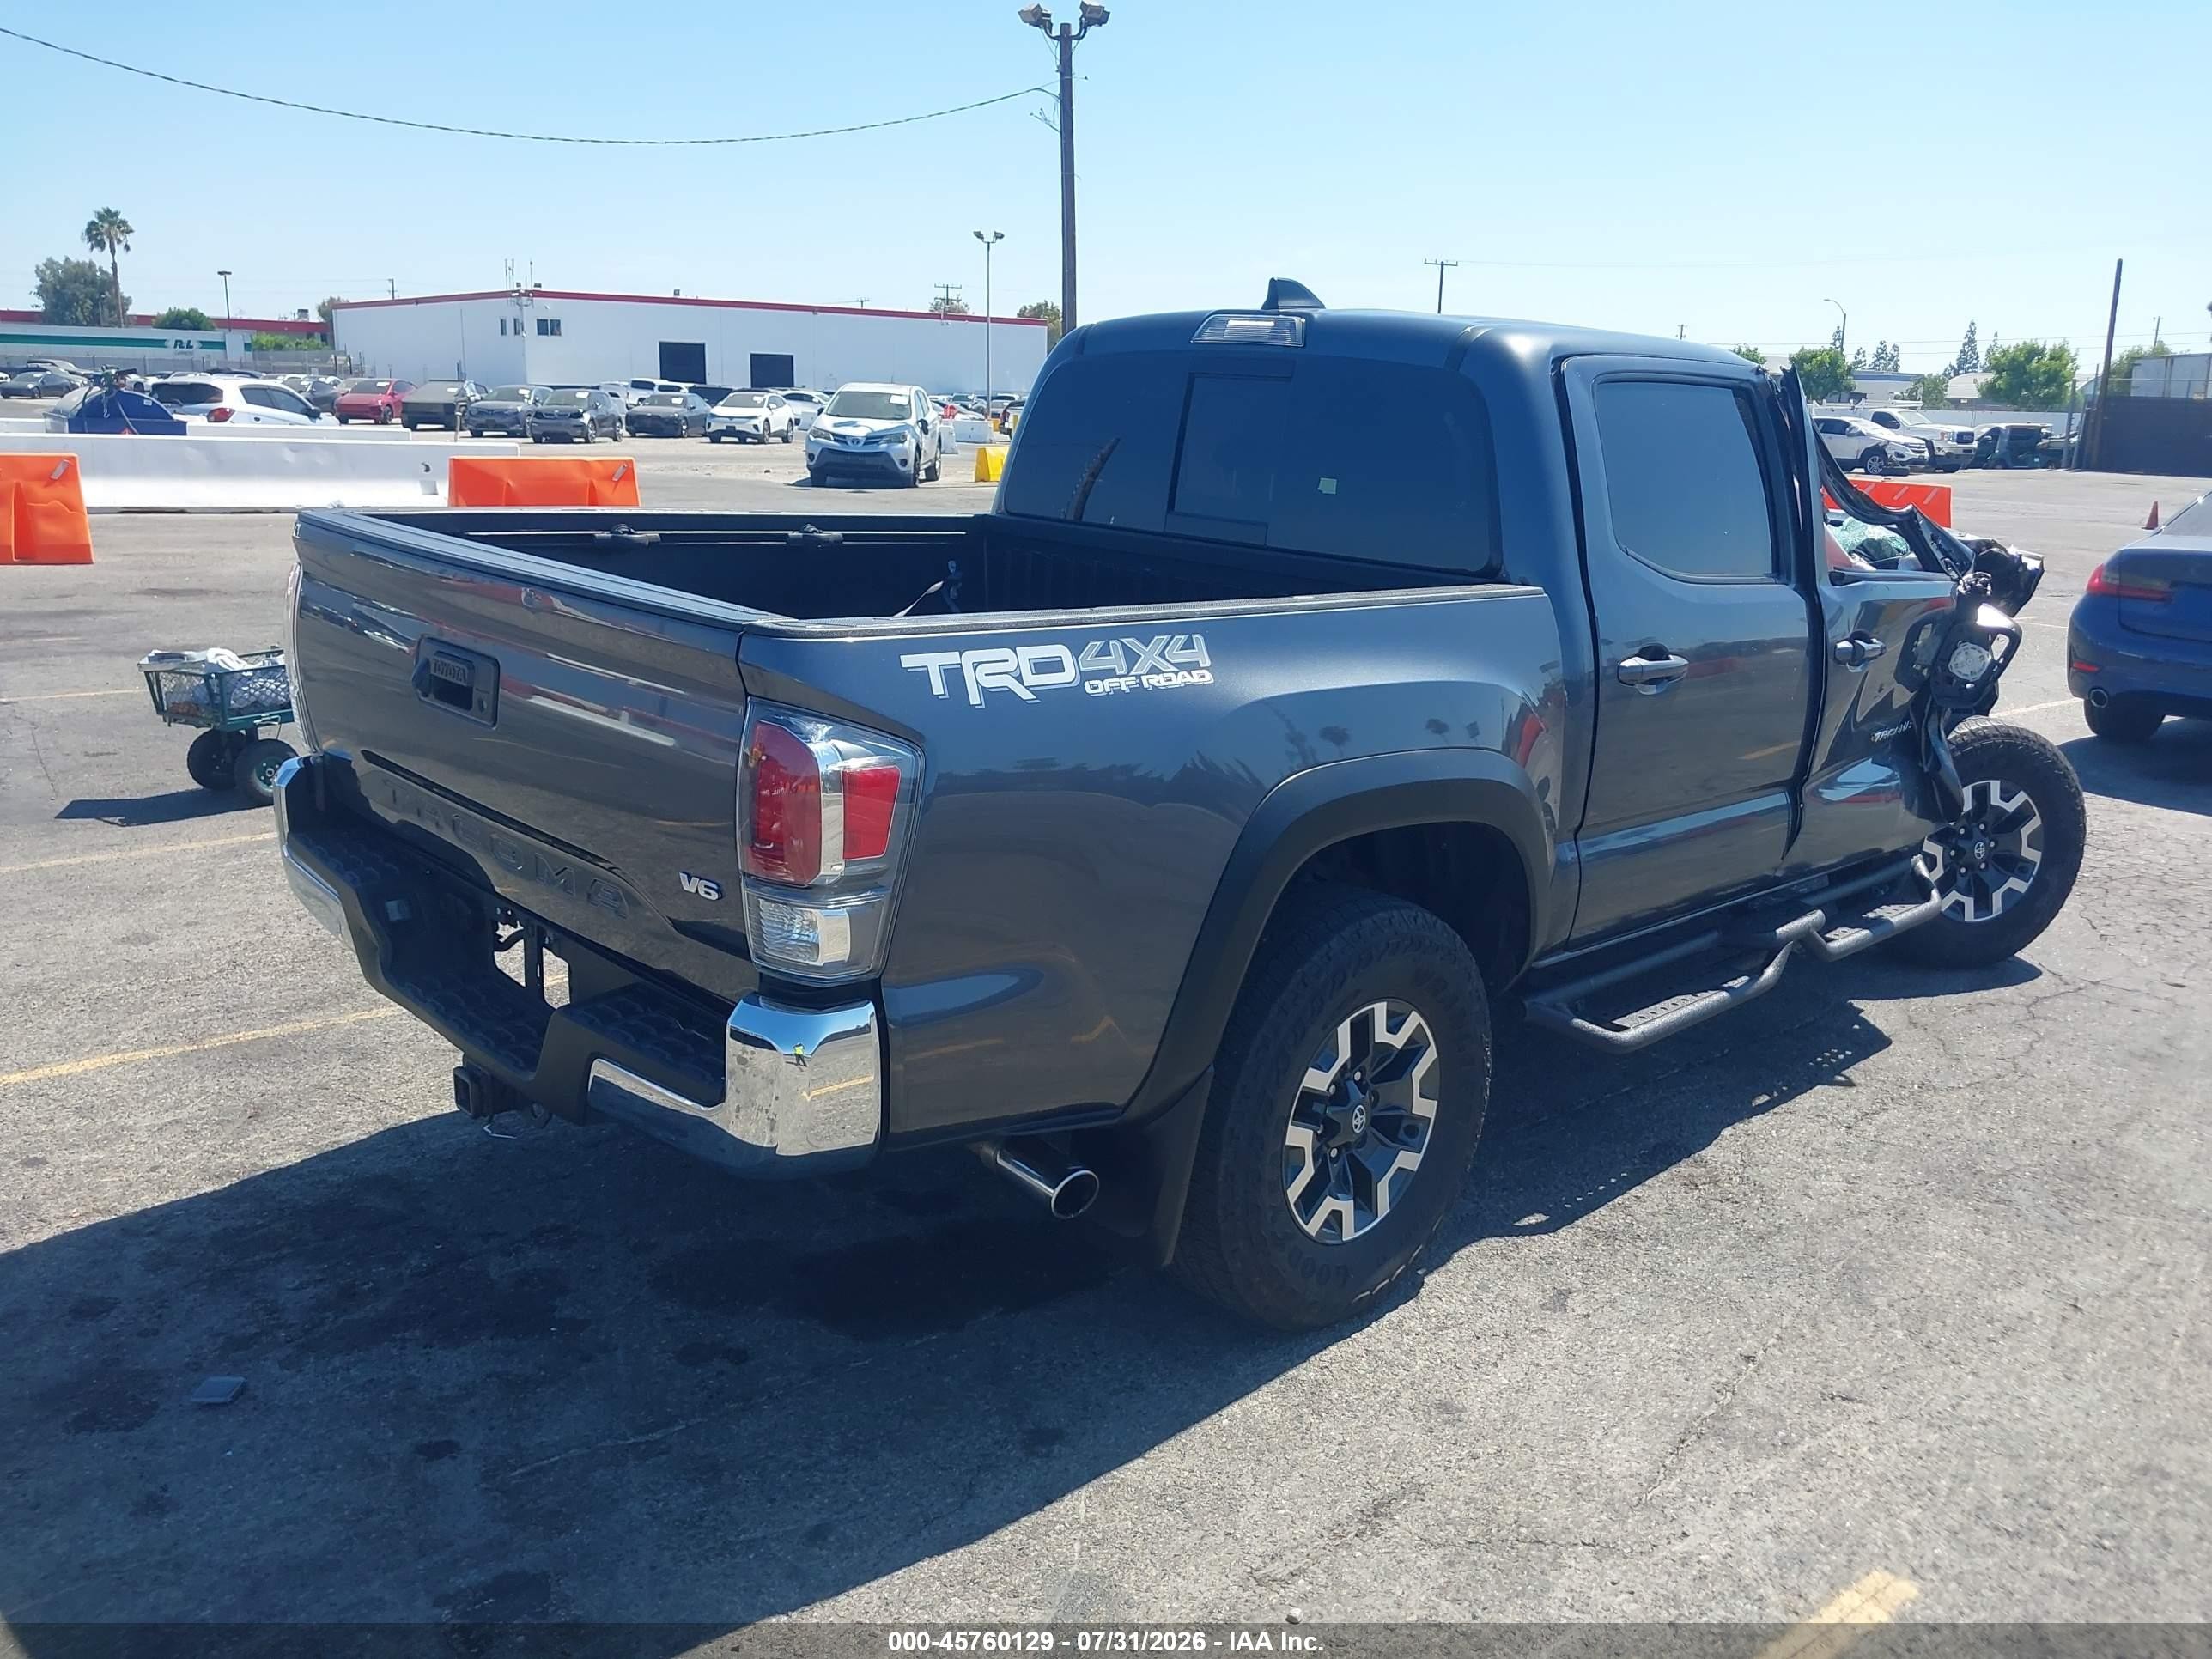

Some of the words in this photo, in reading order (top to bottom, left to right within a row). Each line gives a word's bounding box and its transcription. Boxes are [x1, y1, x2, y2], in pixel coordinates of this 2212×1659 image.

[431, 658, 468, 685] TOYOTA
[900, 644, 1079, 709] TRD
[1084, 676, 1139, 696] OFF
[1142, 668, 1214, 691] ROAD
[678, 872, 721, 901] V6
